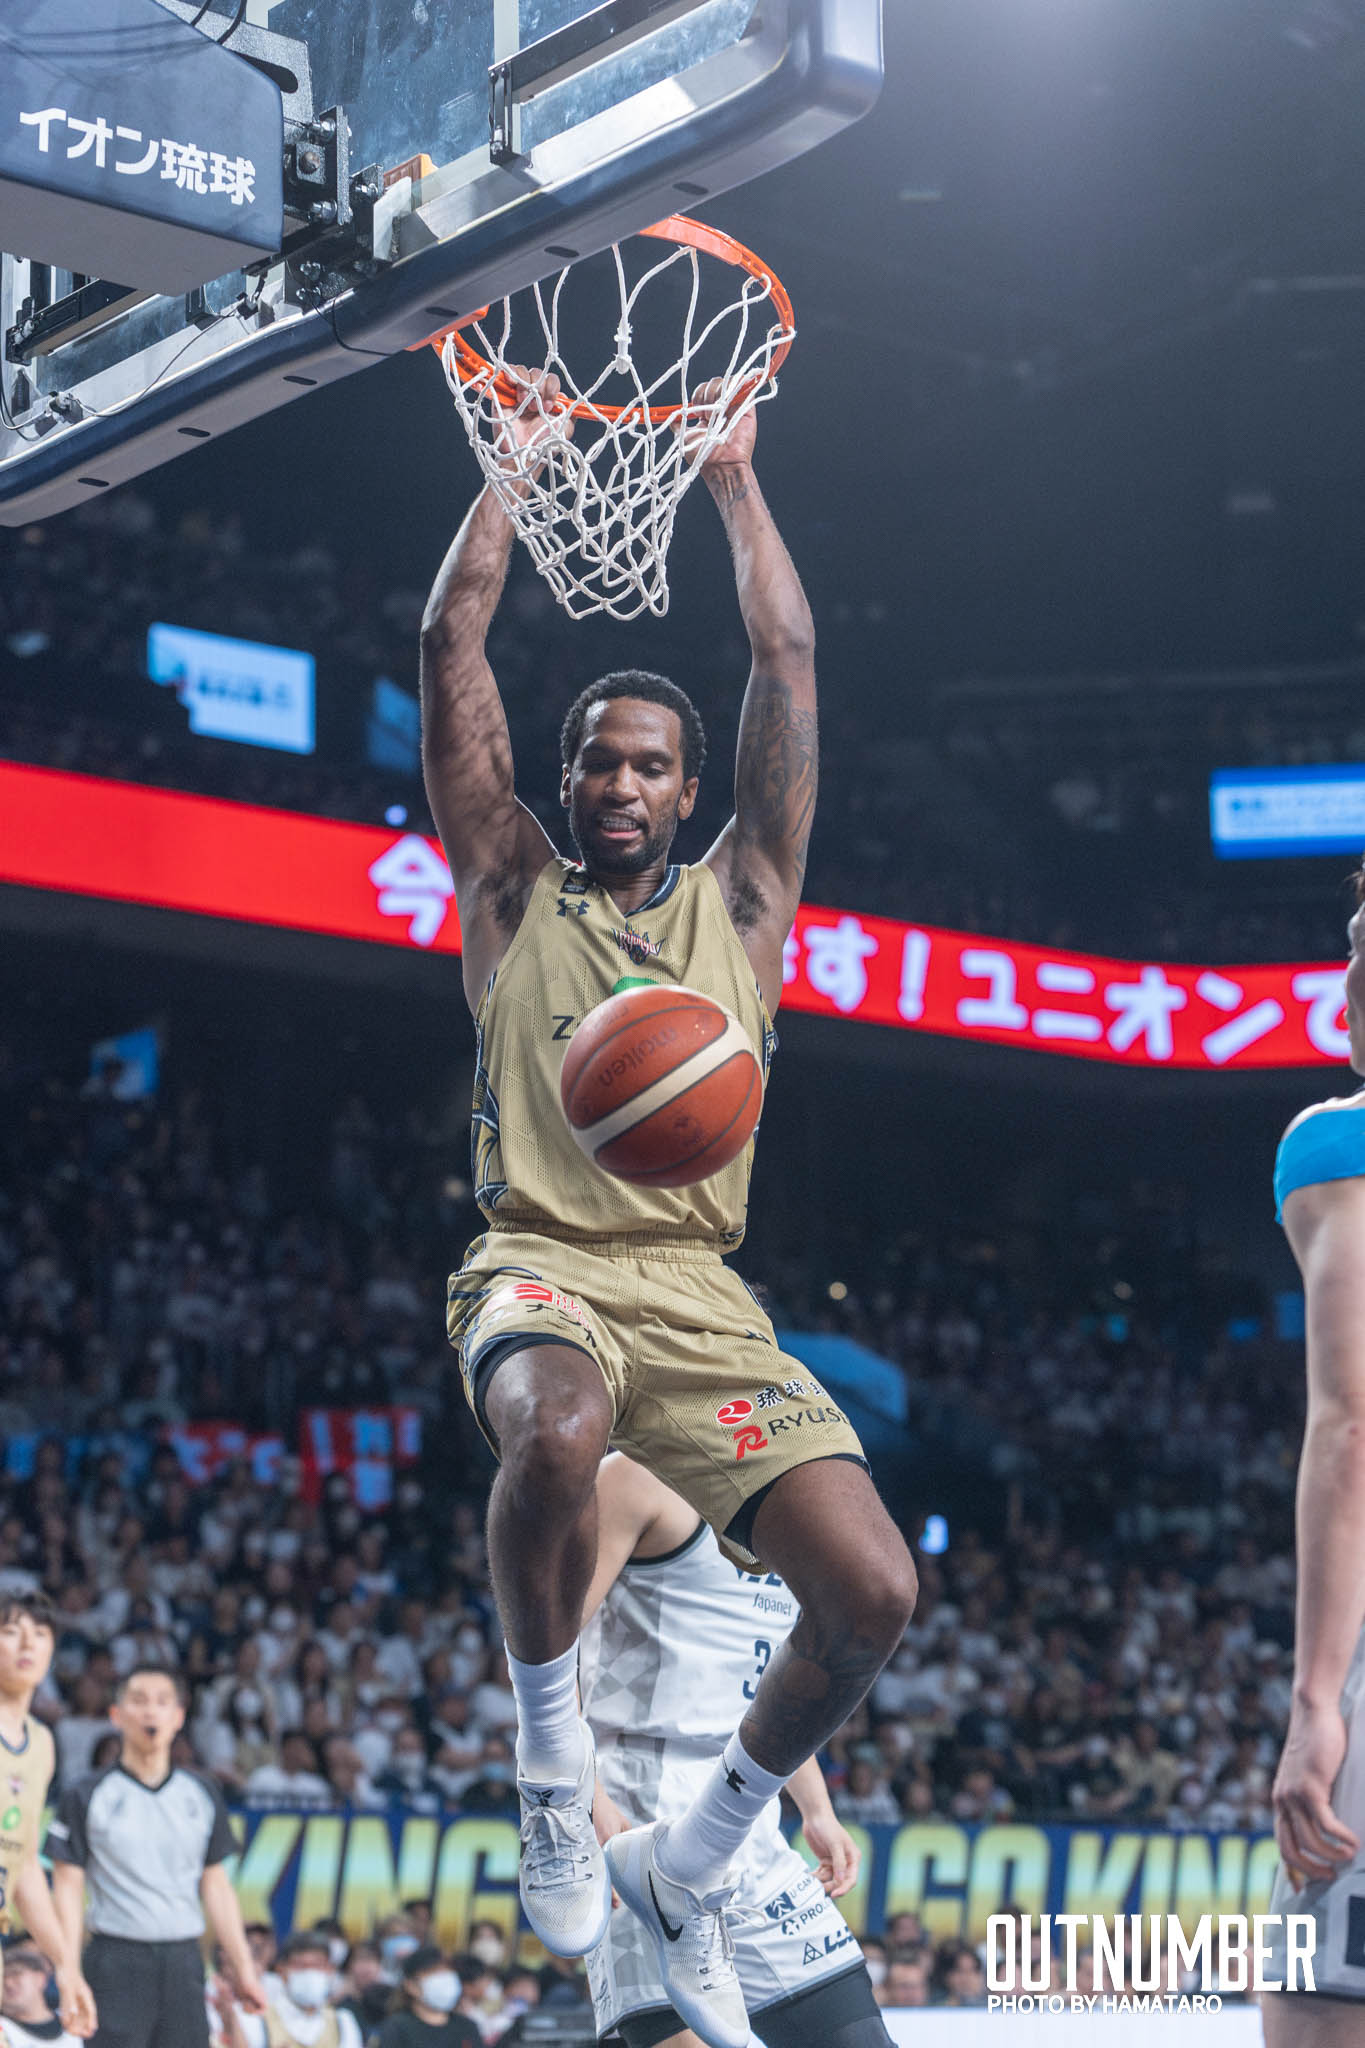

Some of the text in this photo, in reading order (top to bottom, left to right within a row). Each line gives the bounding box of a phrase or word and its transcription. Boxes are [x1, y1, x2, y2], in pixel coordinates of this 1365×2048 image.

[19, 107, 256, 206] イオン琉球
[752, 1592, 793, 1617] Japanet
[742, 1639, 779, 1701] 3
[799, 1903, 827, 1925] PRO
